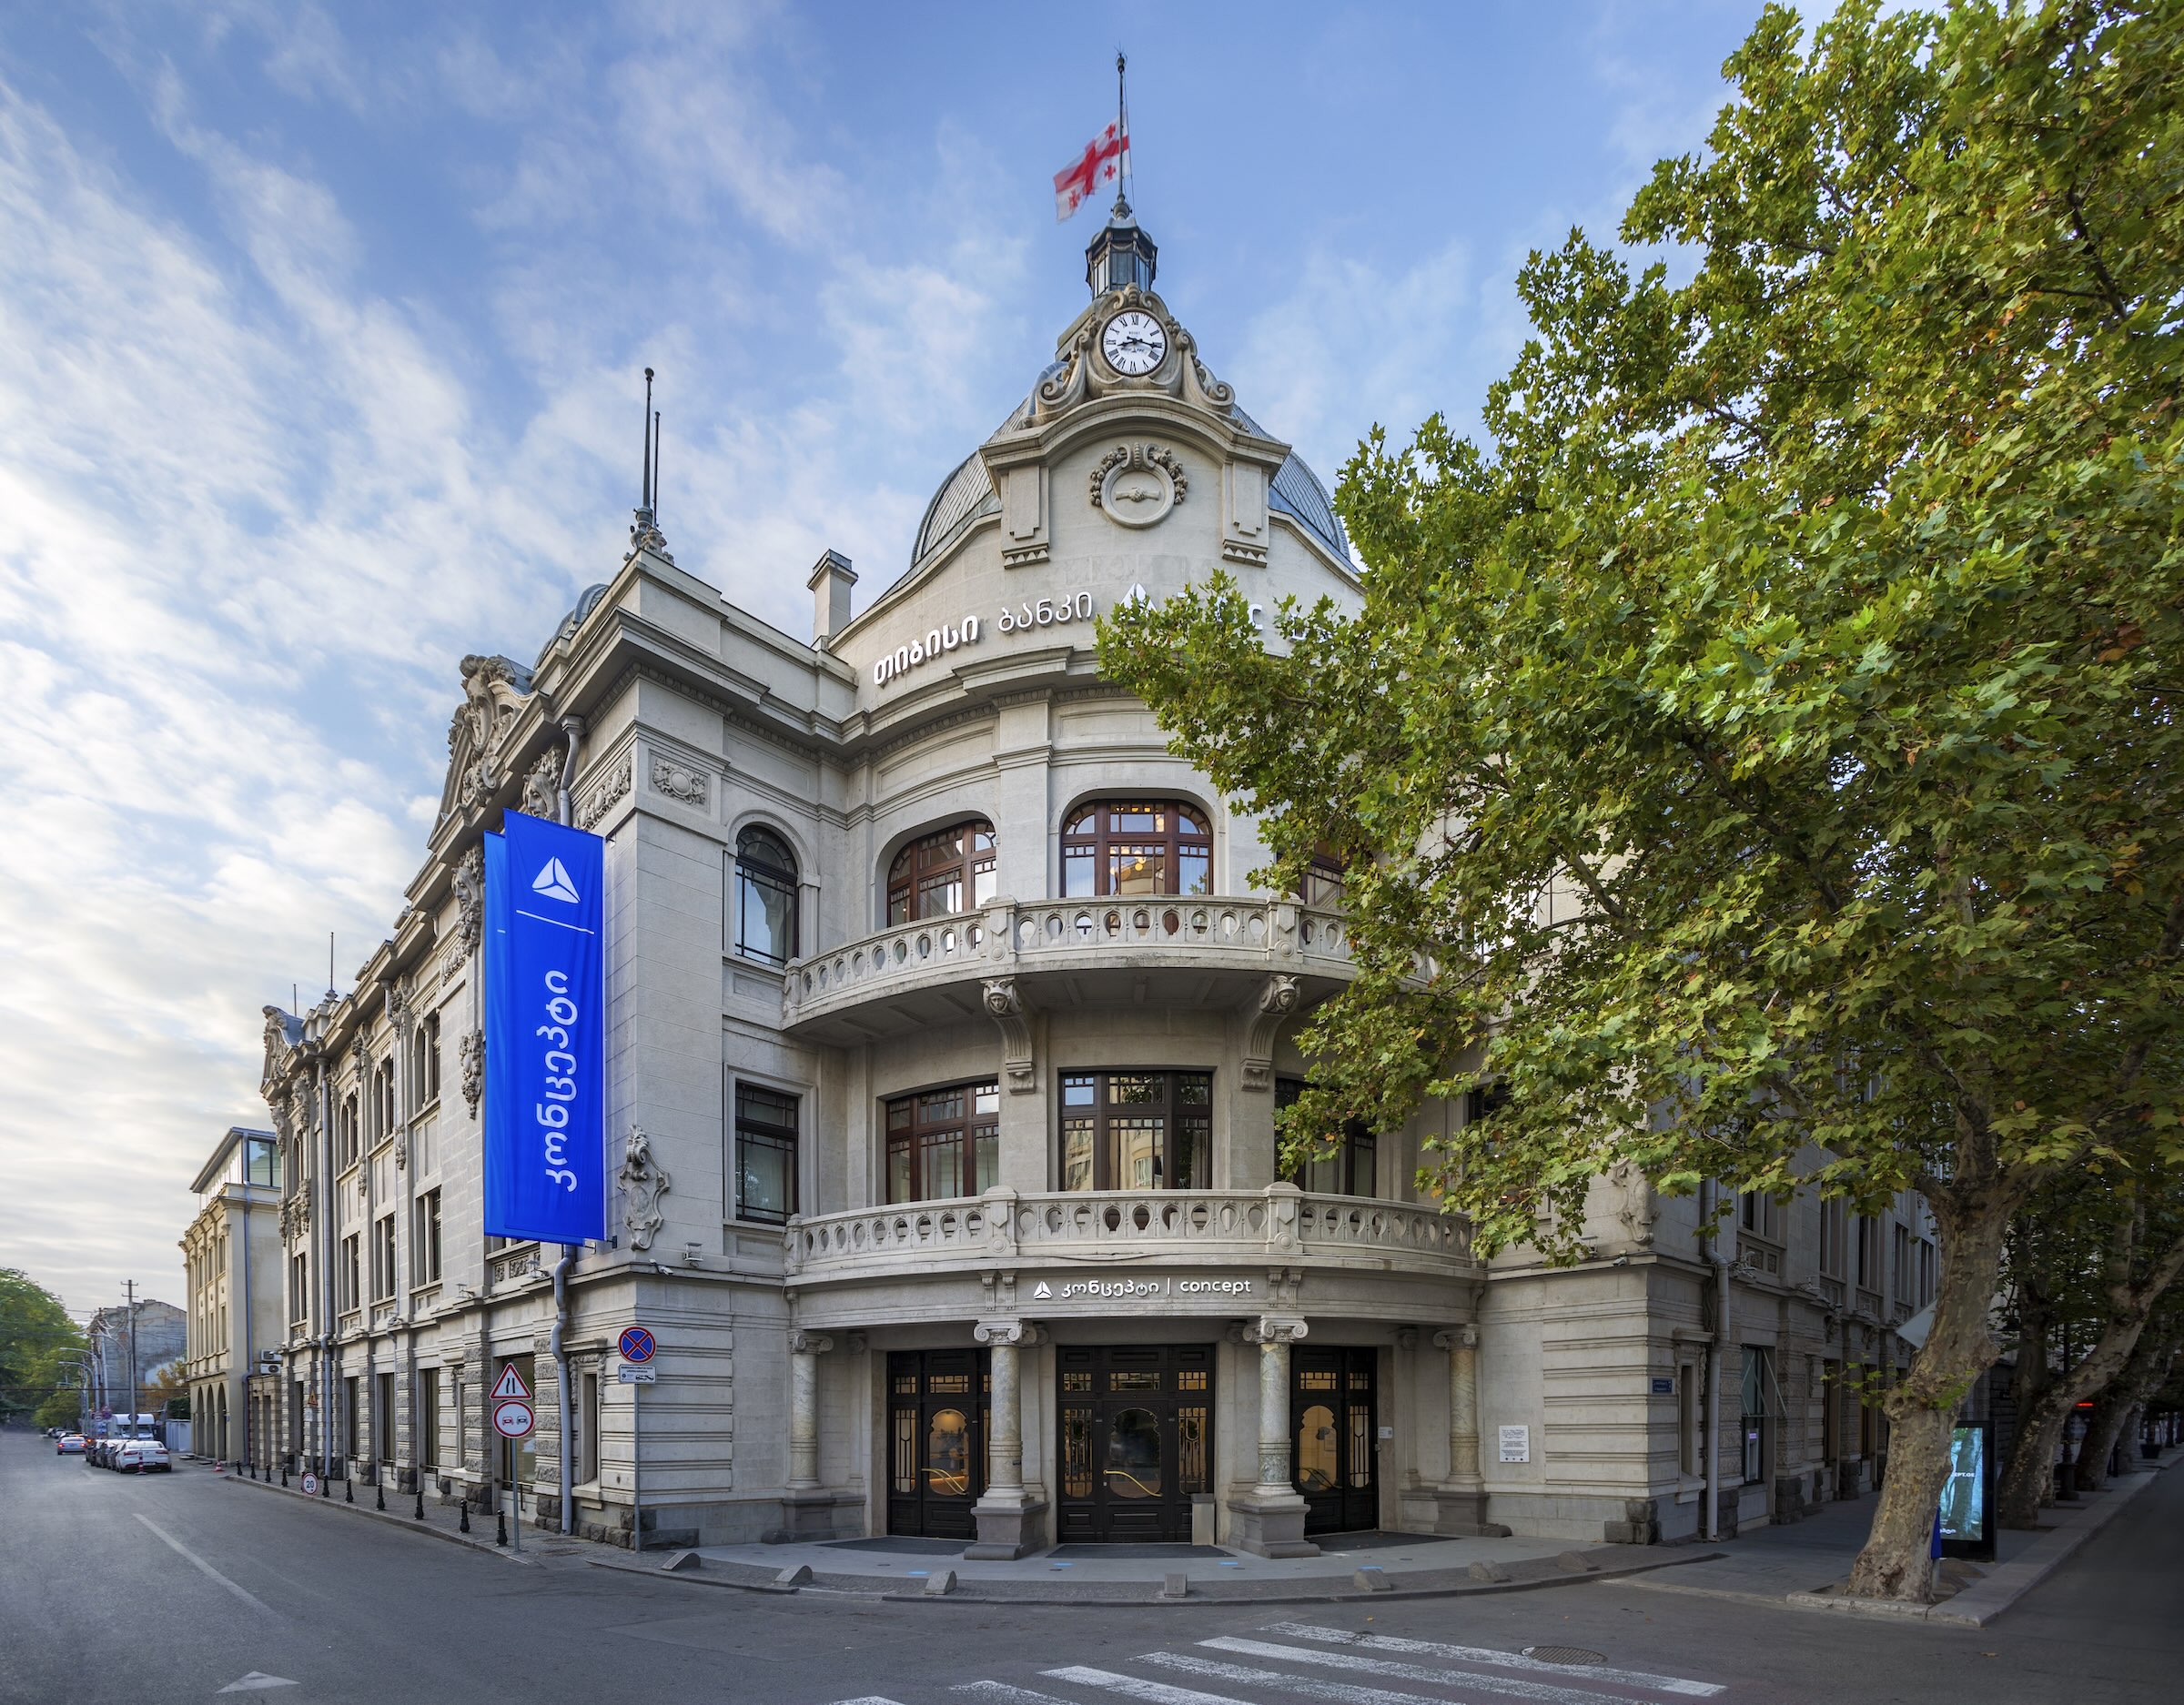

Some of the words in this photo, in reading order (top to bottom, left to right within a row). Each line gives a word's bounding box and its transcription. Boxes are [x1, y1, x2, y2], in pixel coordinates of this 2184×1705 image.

[998, 590, 1092, 631] ბანკი
[537, 970, 579, 1193] კონცეპტი
[1061, 1279, 1160, 1297] კონცეპტი
[1179, 1279, 1252, 1296] concept
[306, 1480, 315, 1488] 20
